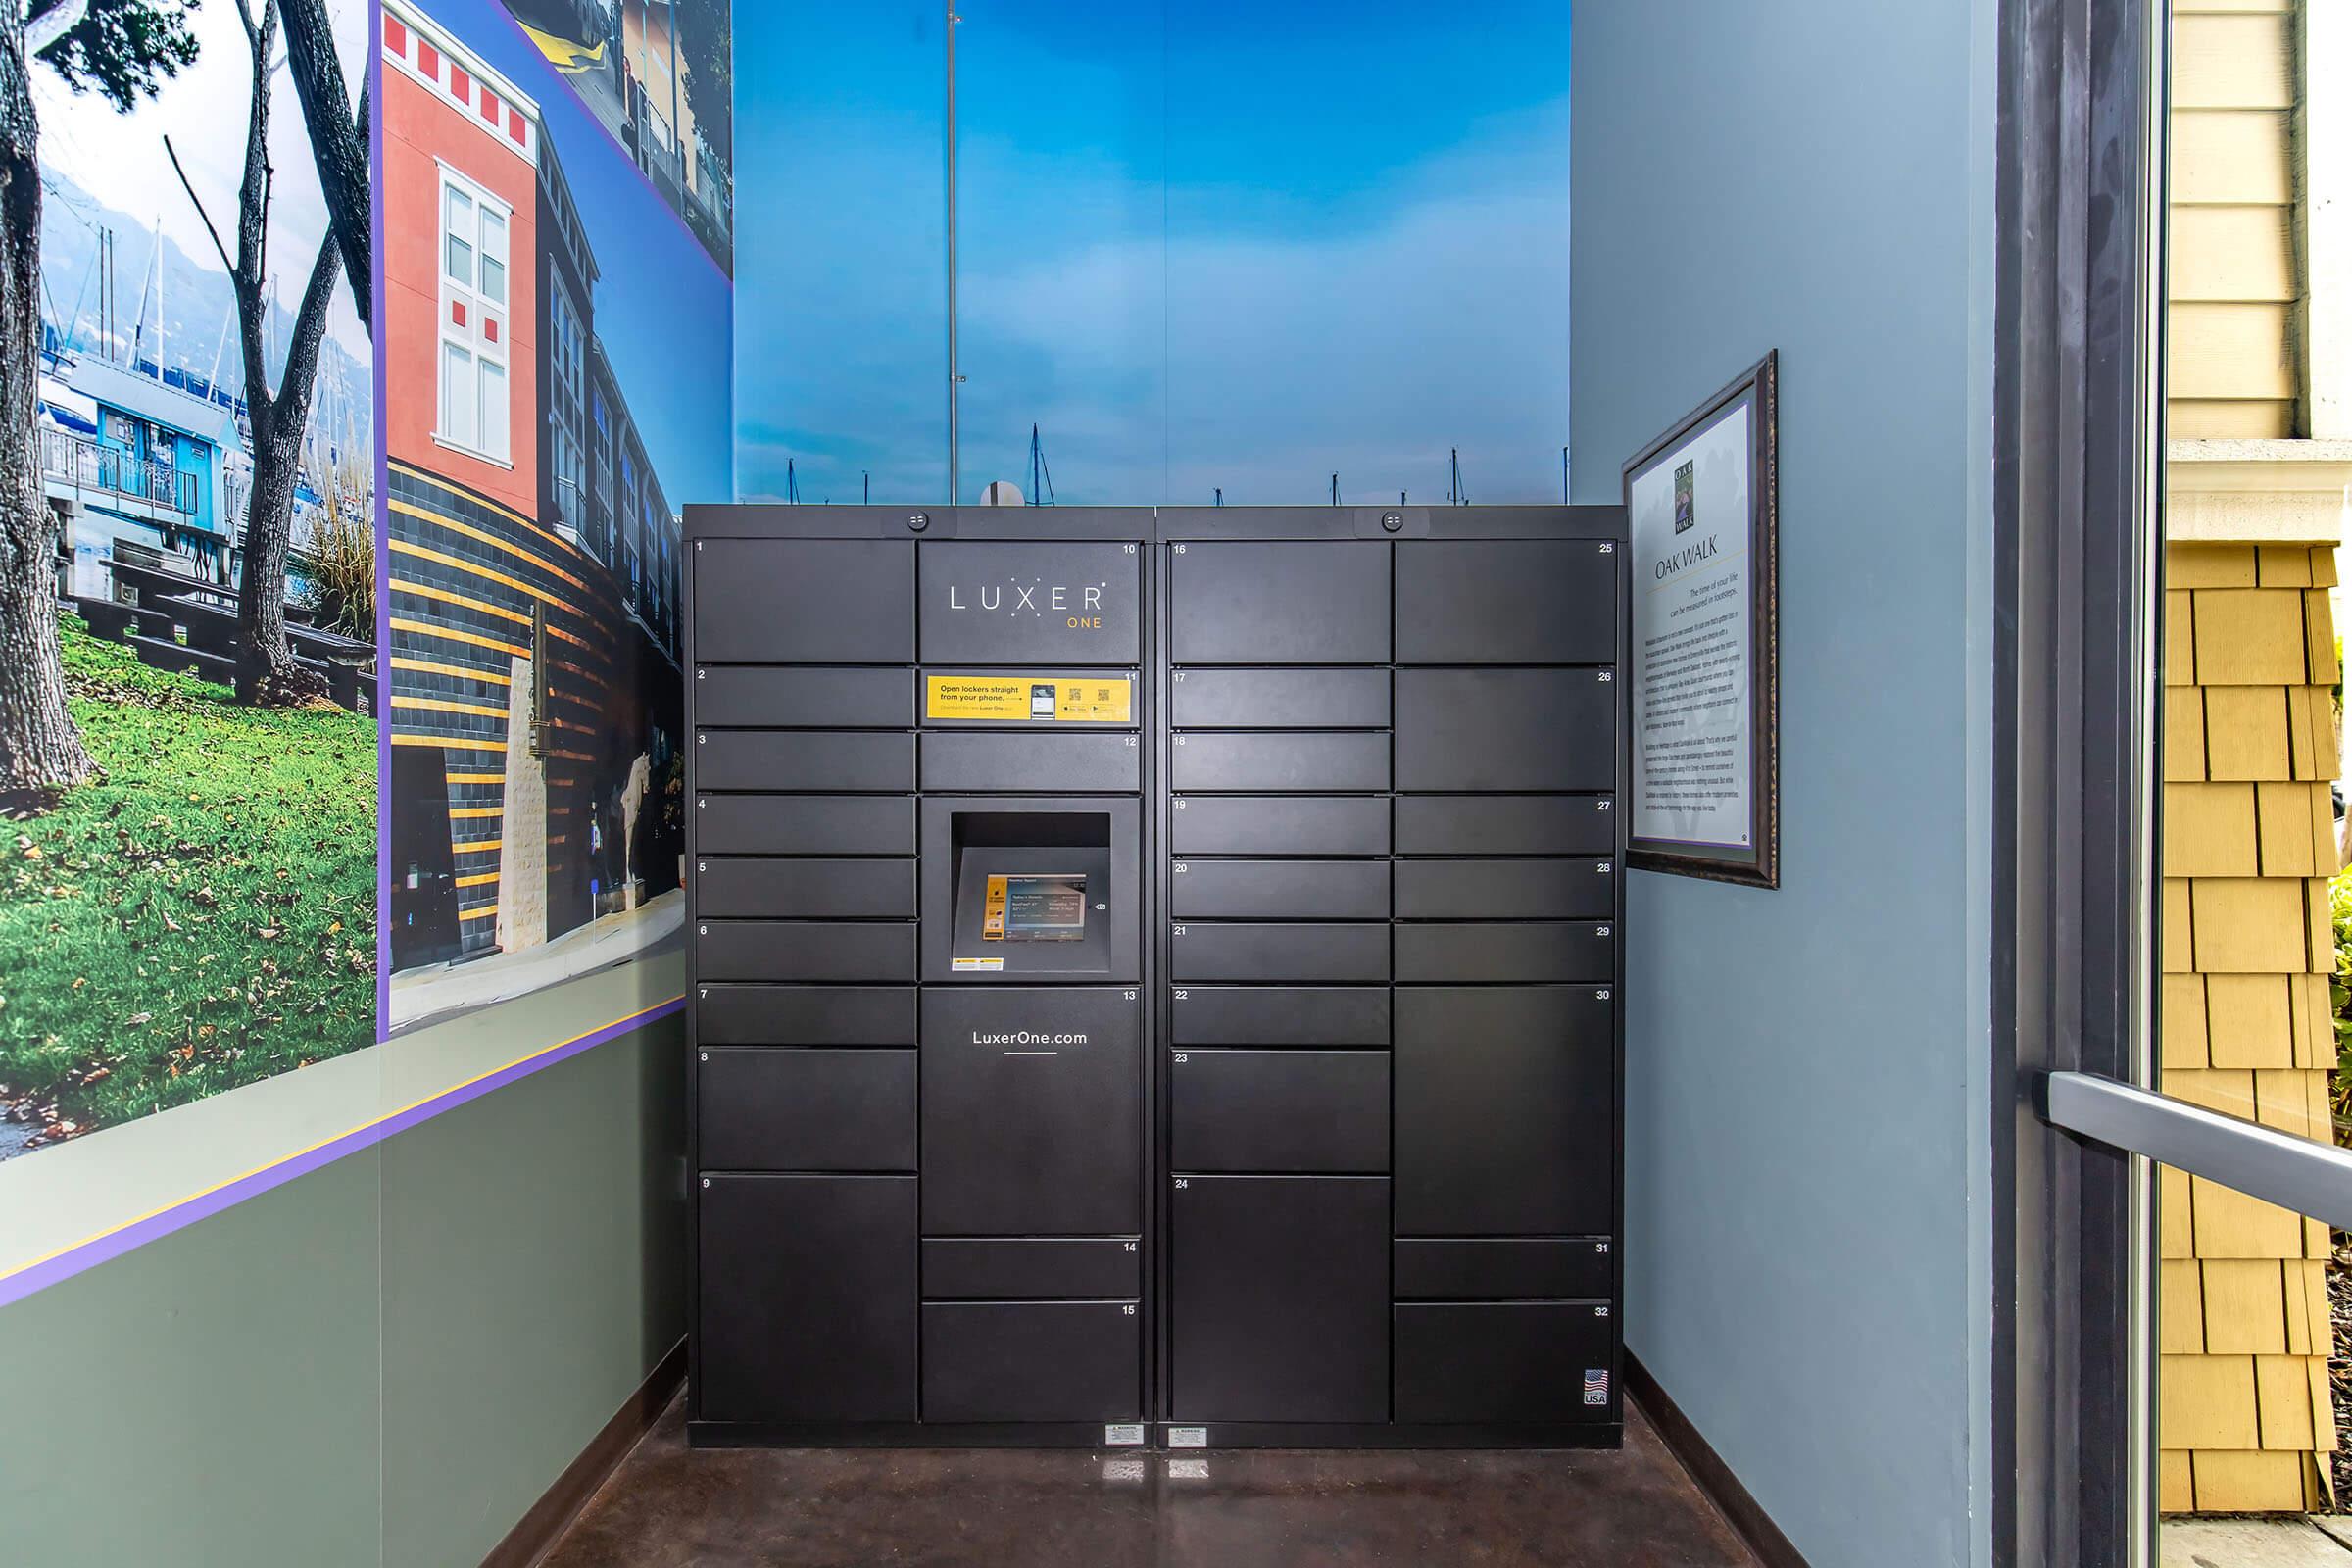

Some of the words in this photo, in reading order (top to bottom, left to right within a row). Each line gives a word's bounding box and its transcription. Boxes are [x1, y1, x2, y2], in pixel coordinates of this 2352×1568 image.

[1675, 462, 1693, 480] OAK
[1676, 515, 1694, 533] WALK
[697, 542, 703, 551] 1
[1123, 544, 1136, 554] 10
[1174, 545, 1186, 554] 16
[1599, 544, 1612, 553] 25
[1655, 554, 1680, 580] OAK
[1682, 534, 1718, 567] WALK
[950, 585, 1102, 610] LUXER
[1066, 617, 1102, 628] ONE
[698, 670, 706, 679] 2
[1174, 673, 1186, 682] 17
[1598, 672, 1611, 681] 26
[940, 684, 960, 694] Open
[961, 684, 989, 694] lockers
[990, 685, 1019, 695] straight
[959, 694, 976, 703] your
[978, 693, 1004, 704] phone.
[699, 735, 706, 744] 3
[1124, 737, 1137, 746] 12
[699, 800, 706, 808] 4
[1174, 800, 1186, 808] 19
[1597, 802, 1610, 810] 27
[1175, 863, 1188, 872] 20
[1597, 863, 1610, 872] 28
[700, 926, 707, 935] 6
[1174, 926, 1186, 935] 21
[1596, 927, 1609, 936] 29
[700, 989, 708, 998] 7
[1123, 991, 1136, 1000] 13
[1175, 990, 1188, 999] 22
[1596, 991, 1609, 1000] 30
[972, 1031, 1088, 1044] LuxerOne.com
[701, 1053, 708, 1061] 8
[1175, 1054, 1188, 1062] 23
[703, 1179, 710, 1188] 9
[1176, 1179, 1188, 1189] 24
[1124, 1243, 1136, 1251] 14
[1596, 1244, 1608, 1252] 31
[1122, 1305, 1135, 1315] 15
[1595, 1307, 1608, 1316] 32
[1585, 1395, 1605, 1403] USA
